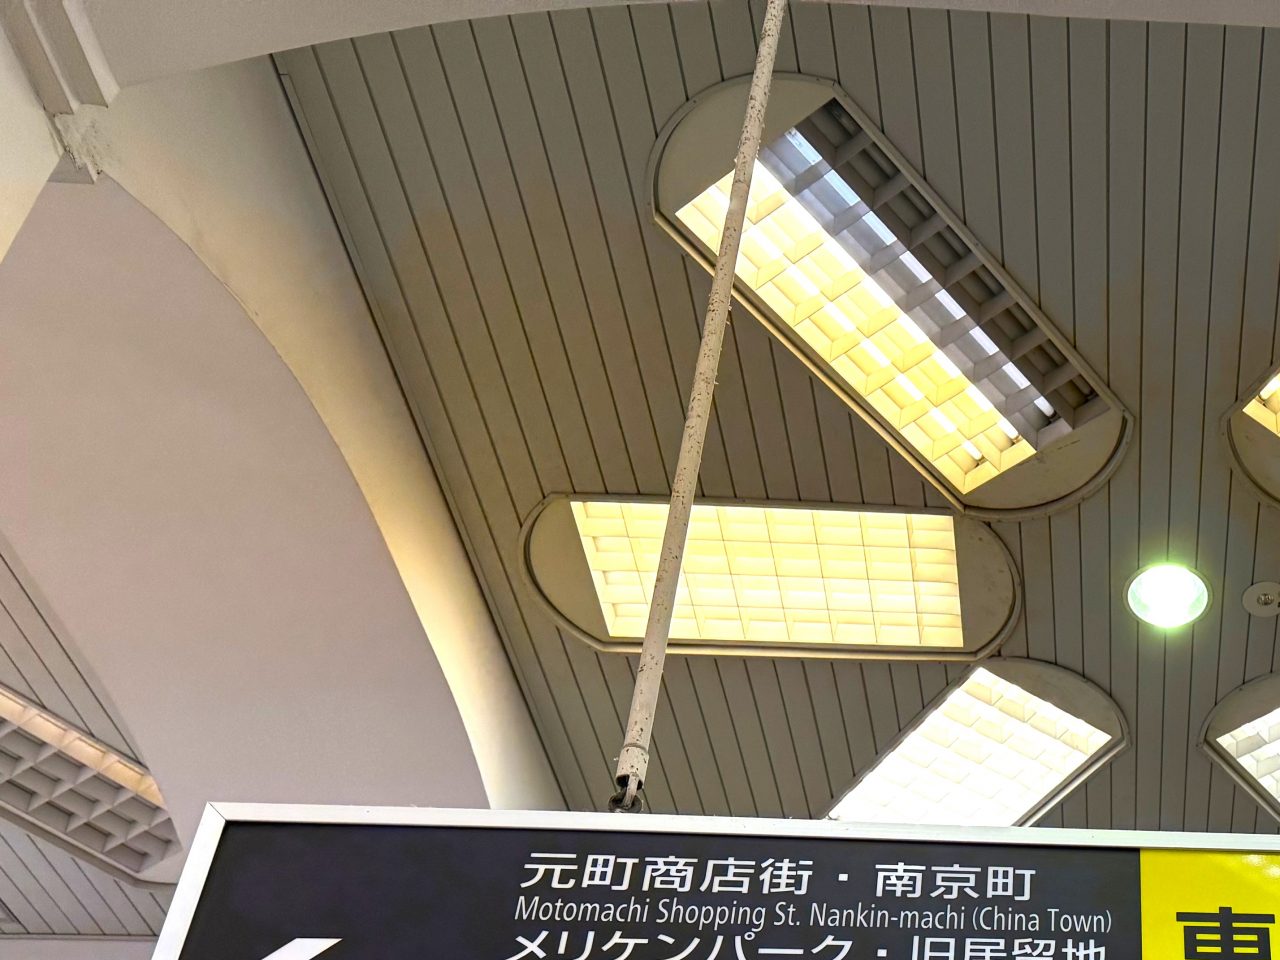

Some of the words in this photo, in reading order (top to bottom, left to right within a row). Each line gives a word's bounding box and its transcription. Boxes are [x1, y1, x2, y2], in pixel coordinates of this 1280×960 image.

[520, 853, 1035, 900] 元町商店街・南京町
[515, 896, 649, 922] Motomachi
[656, 898, 765, 931] Shopping
[774, 902, 799, 925] St.
[810, 902, 964, 929] Nankin-machi
[973, 906, 1039, 931] (China
[1048, 909, 1111, 932] Town)
